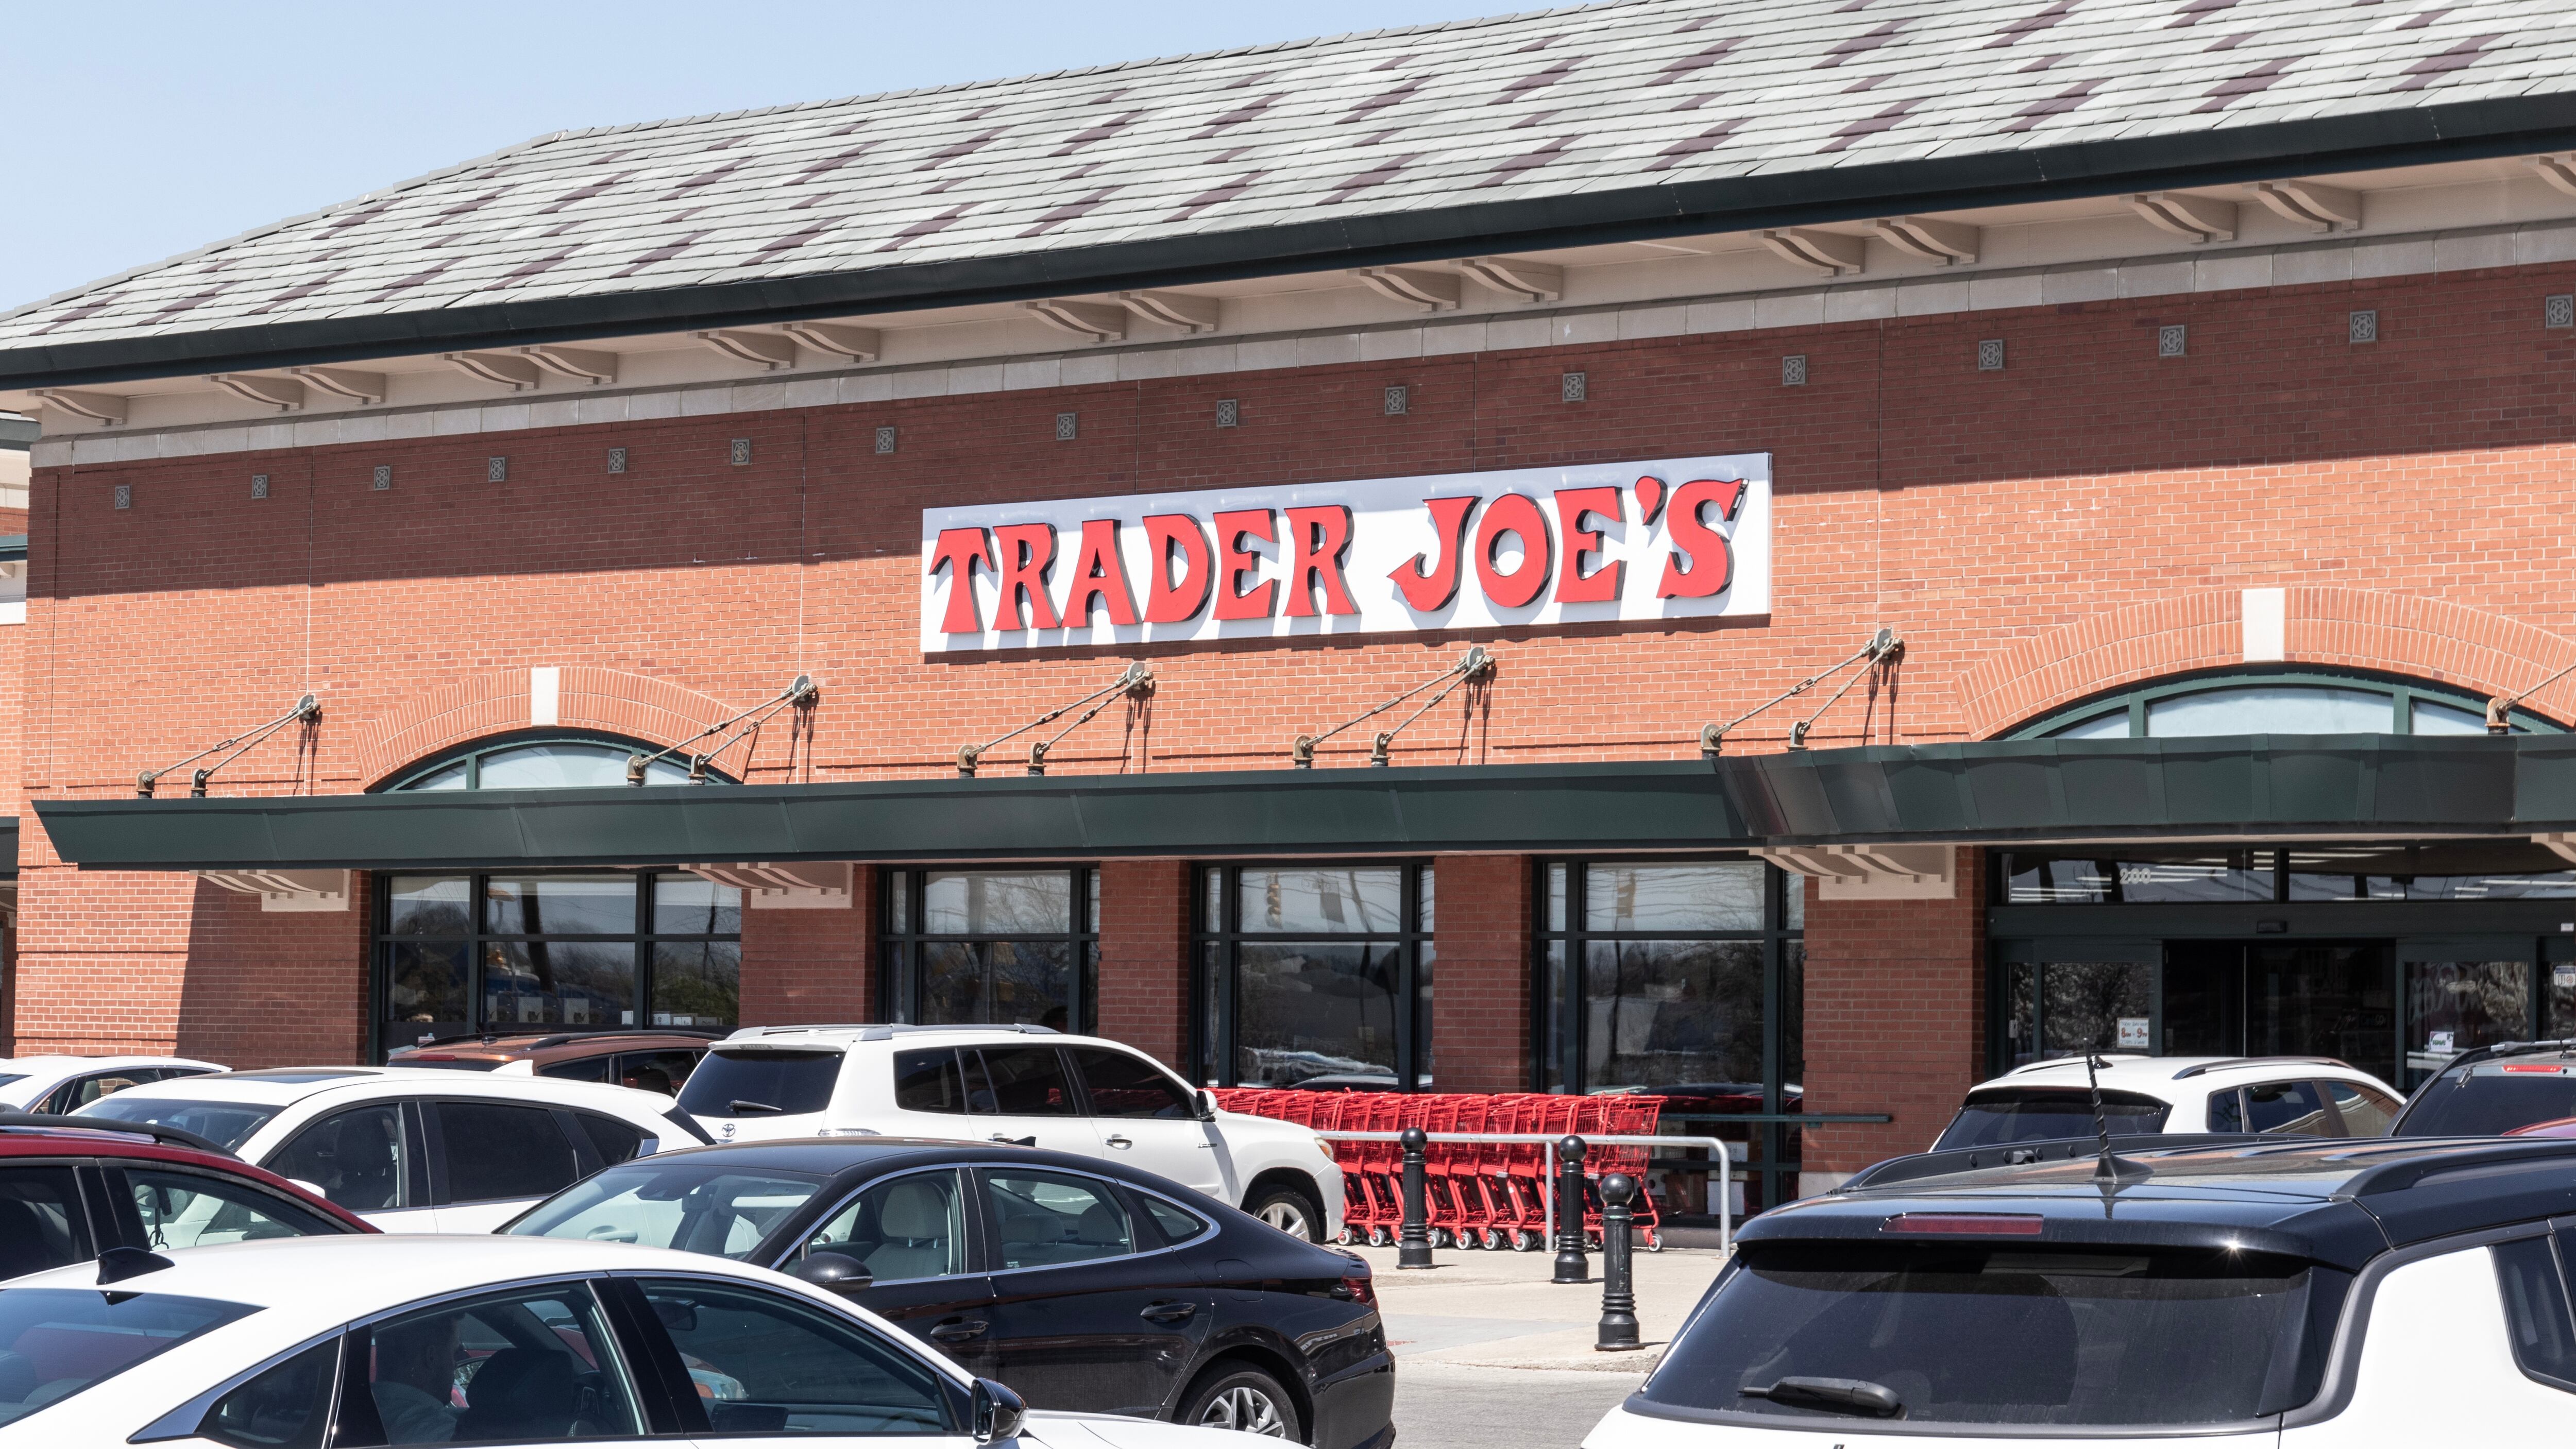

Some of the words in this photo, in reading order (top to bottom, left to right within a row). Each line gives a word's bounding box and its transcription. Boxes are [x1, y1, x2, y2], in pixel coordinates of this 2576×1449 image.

[929, 505, 1361, 634] TRADER
[1387, 475, 1750, 612] JOE'S
[2120, 867, 2151, 885] 200
